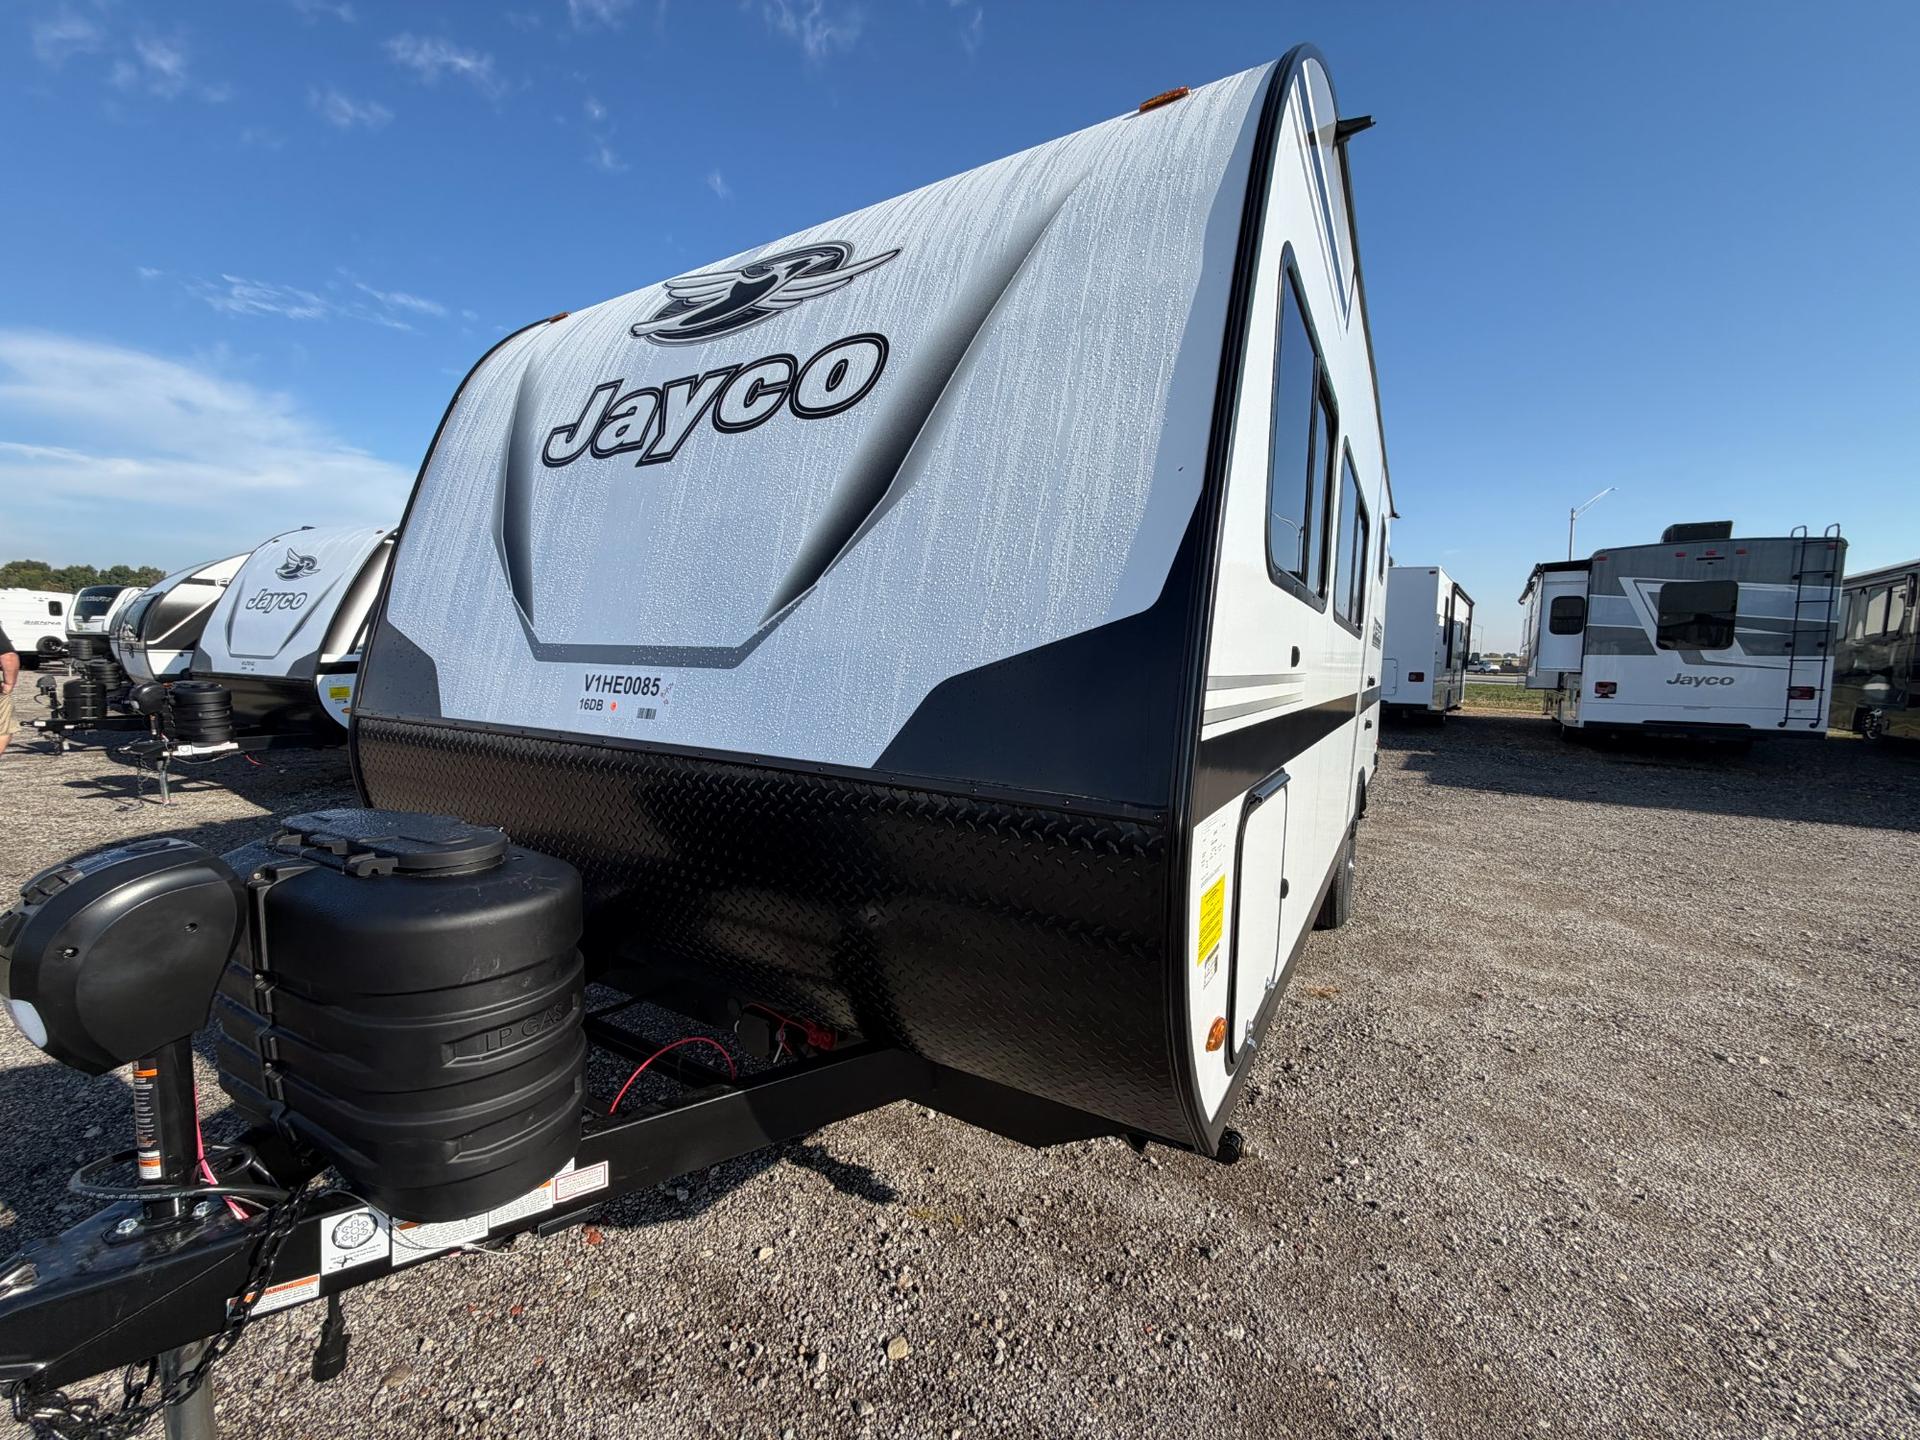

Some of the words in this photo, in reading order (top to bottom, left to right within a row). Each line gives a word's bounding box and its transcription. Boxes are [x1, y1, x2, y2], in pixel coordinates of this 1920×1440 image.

[542, 332, 890, 467] Jayco
[245, 588, 307, 614] Jayco
[584, 673, 661, 697] V1HE0085
[1666, 672, 1735, 688] Jayco
[579, 697, 604, 712] 16DB
[485, 1027, 513, 1052] LP
[521, 1003, 563, 1037] GAS
